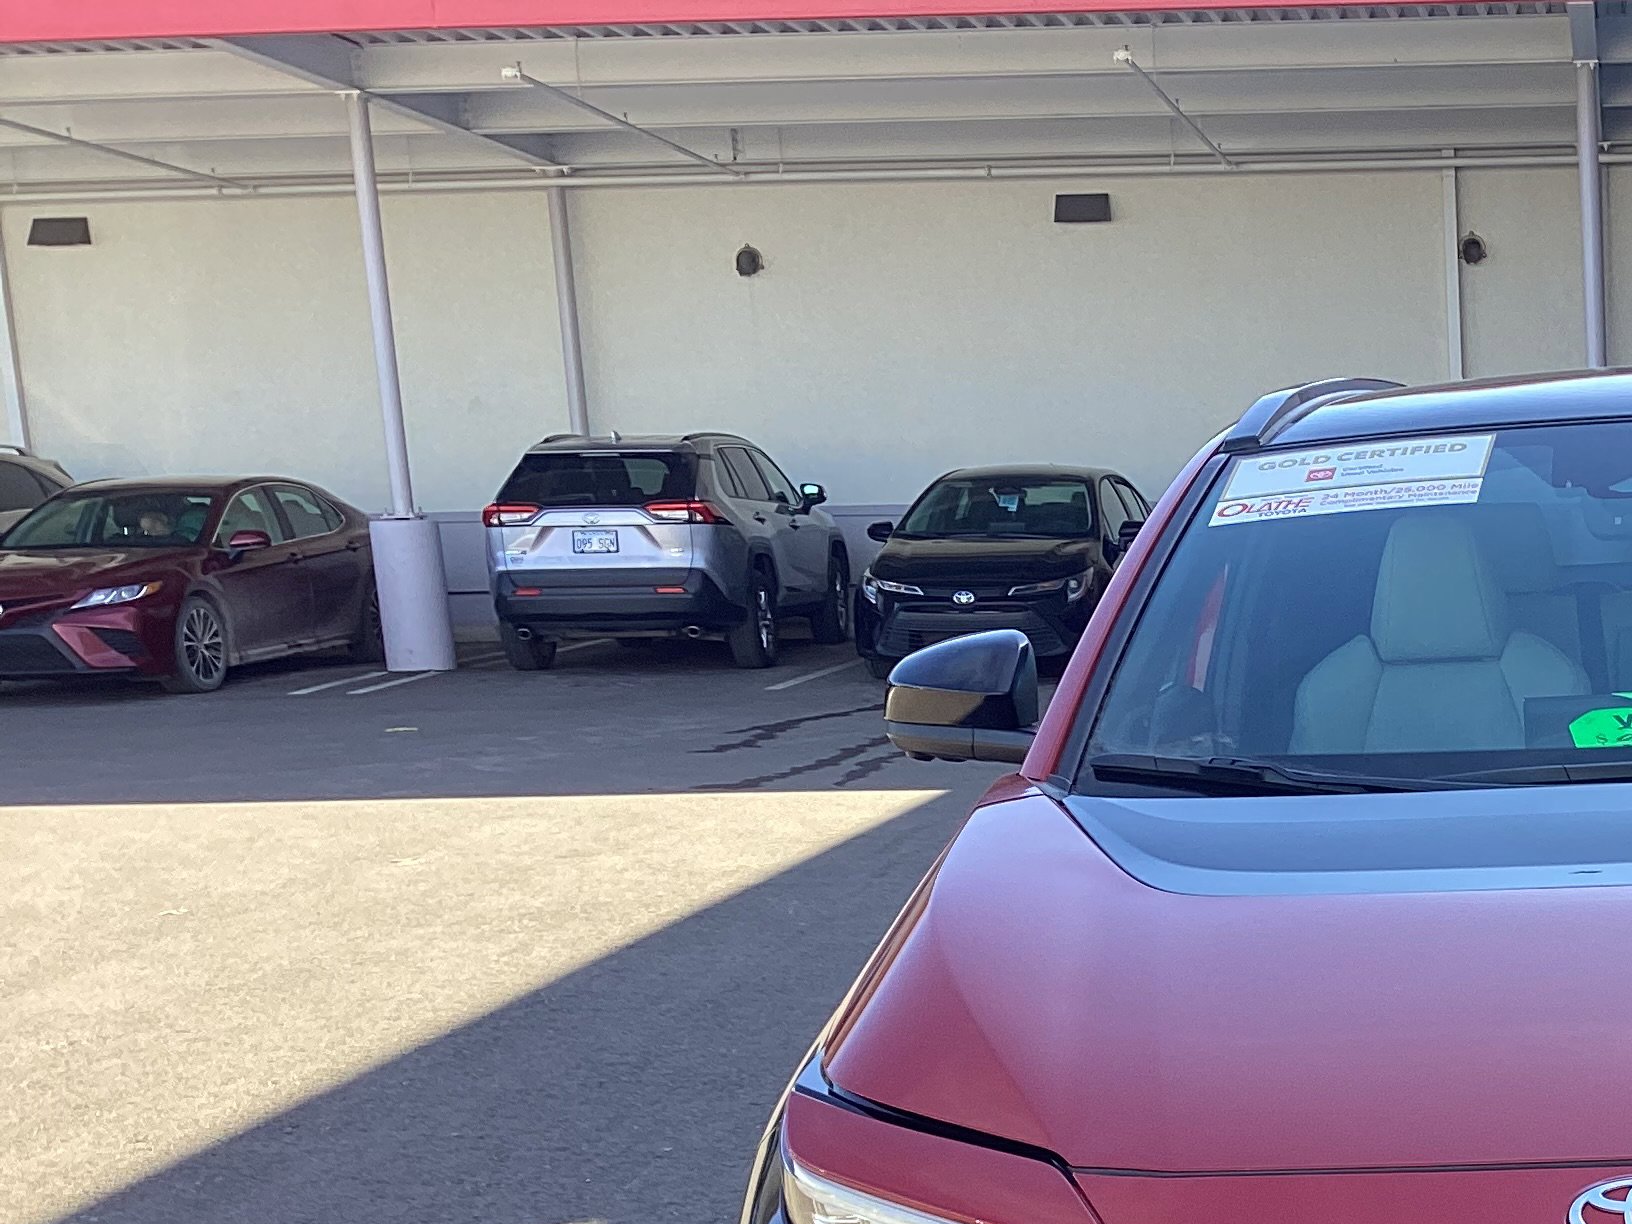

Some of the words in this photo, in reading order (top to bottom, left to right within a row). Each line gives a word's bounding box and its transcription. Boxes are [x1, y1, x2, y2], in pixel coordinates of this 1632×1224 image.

[1258, 455, 1331, 471] GOLD
[1337, 442, 1468, 462] CERTIFIED
[1217, 497, 1315, 517] OLATHE
[1259, 508, 1307, 517] TOYOTA
